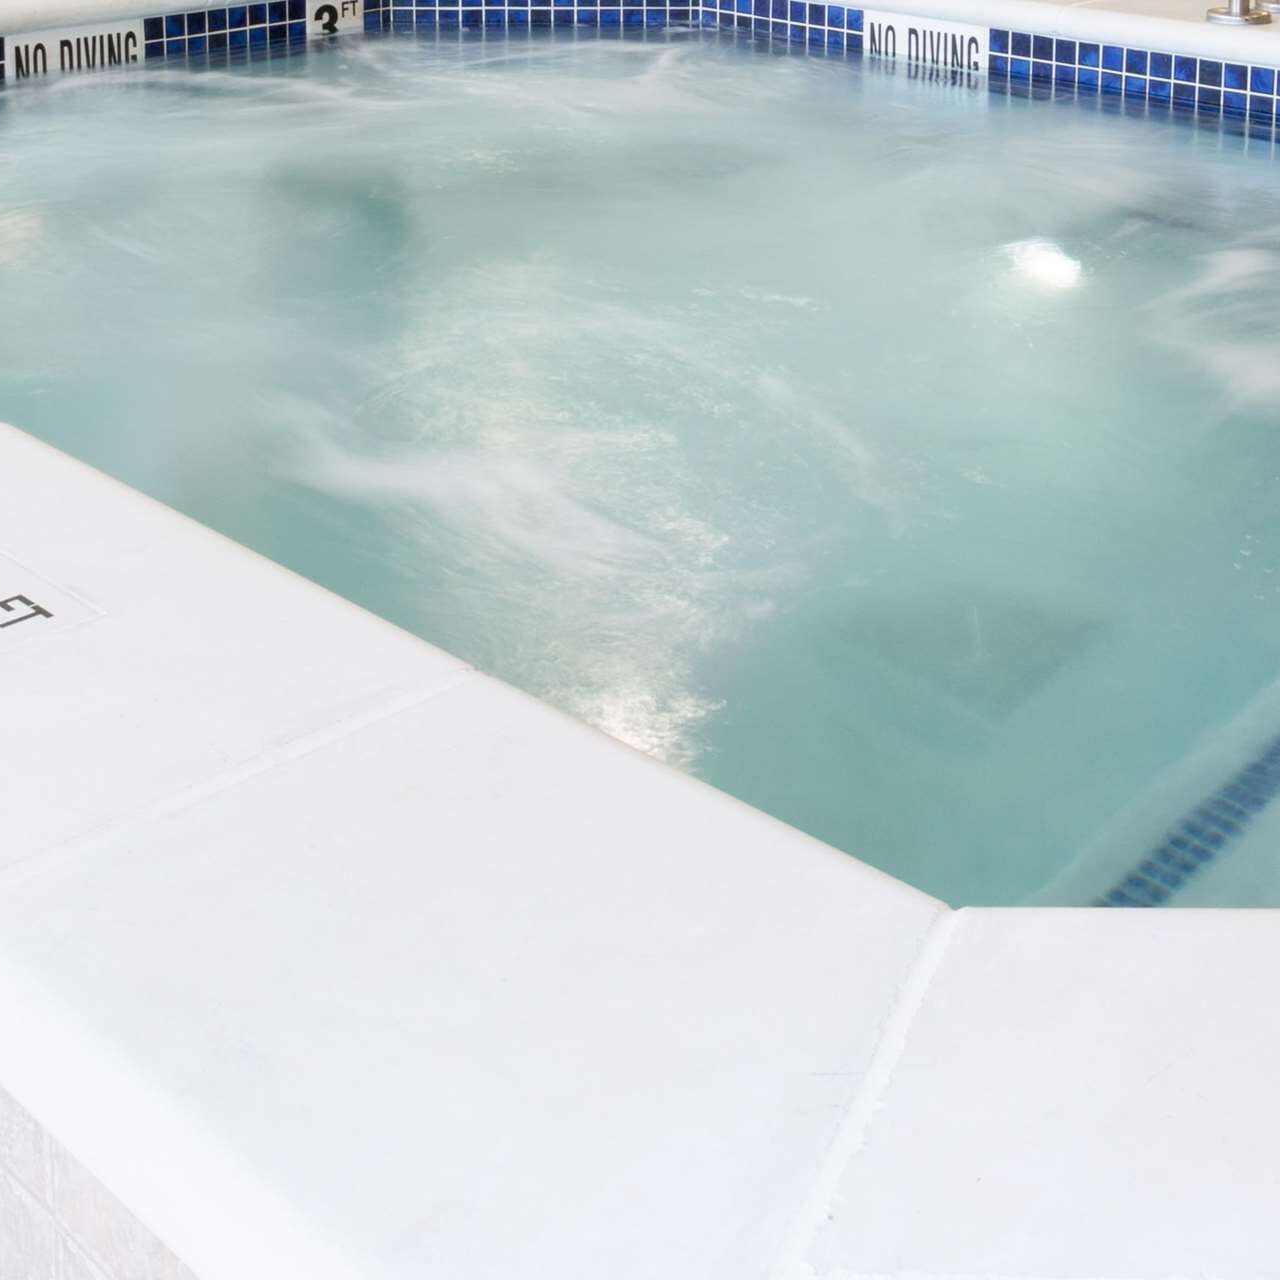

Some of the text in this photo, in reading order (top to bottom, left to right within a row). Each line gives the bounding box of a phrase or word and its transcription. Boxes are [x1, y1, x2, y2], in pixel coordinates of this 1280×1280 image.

[314, 0, 359, 35] 3 FT
[14, 30, 138, 81] NO DIVING
[870, 22, 979, 72] NO DIVING
